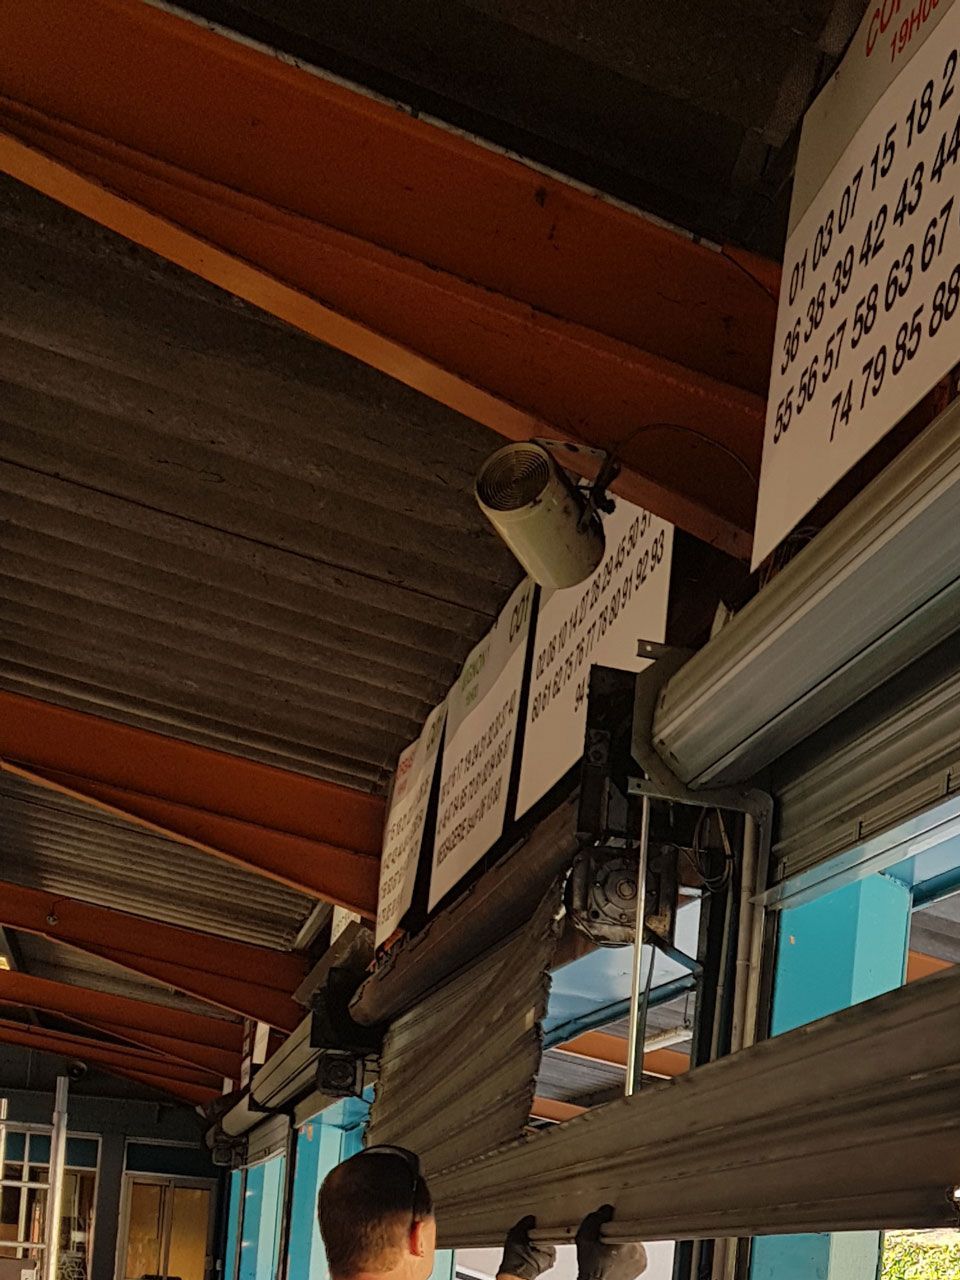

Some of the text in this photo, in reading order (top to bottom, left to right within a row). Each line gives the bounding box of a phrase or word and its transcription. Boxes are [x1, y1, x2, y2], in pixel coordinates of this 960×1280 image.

[781, 317, 801, 375] 36
[804, 282, 826, 343] 38
[830, 245, 854, 309] 39
[859, 204, 887, 267] 42
[893, 161, 925, 227] 43
[789, 248, 808, 306] 01
[813, 210, 834, 271] 03
[838, 166, 864, 234] 07
[870, 123, 897, 191] 15
[906, 79, 934, 148] 18
[773, 386, 795, 444] 55
[796, 354, 818, 415] 56
[822, 318, 848, 383] 57
[851, 283, 879, 349] 58
[885, 243, 914, 312] 63
[921, 195, 954, 272] 67
[830, 379, 853, 442] 74
[860, 345, 887, 410] 79
[892, 303, 924, 376] 85
[552, 665, 563, 699] 62
[563, 650, 574, 687] 75
[585, 619, 597, 658] 77
[597, 604, 609, 642] 78
[608, 587, 622, 627] 80
[621, 568, 634, 610] 91
[635, 549, 649, 592] 92
[650, 529, 665, 573] 93
[569, 604, 579, 639] 14
[601, 555, 614, 594] 29
[614, 535, 627, 573] 45
[626, 516, 640, 557] 50
[574, 676, 586, 713] 94
